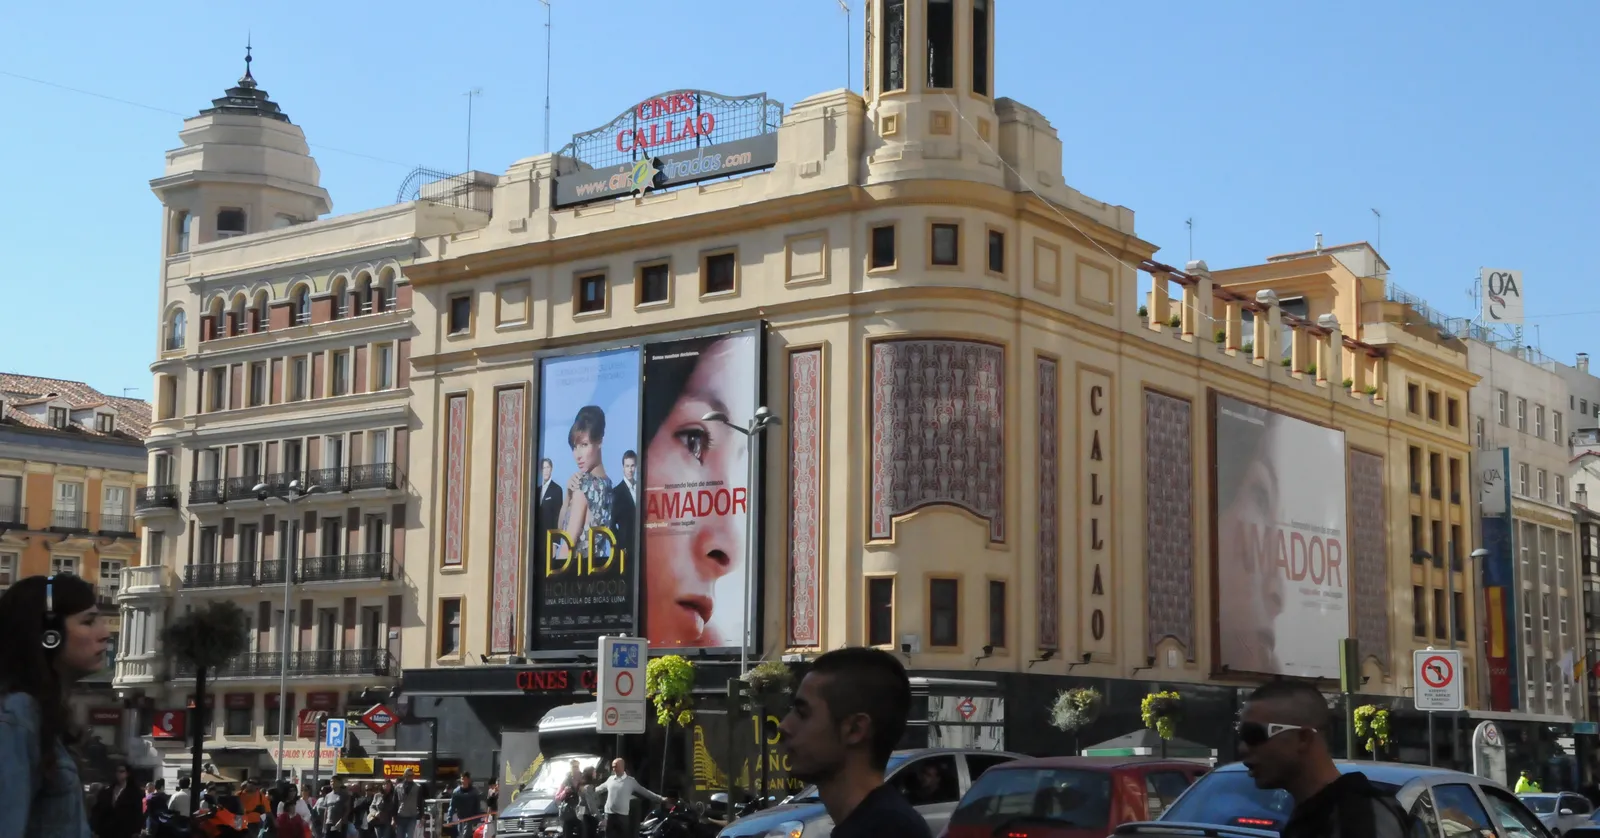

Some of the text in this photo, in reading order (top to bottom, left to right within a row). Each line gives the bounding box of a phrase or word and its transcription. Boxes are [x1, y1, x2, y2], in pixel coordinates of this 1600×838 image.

[636, 91, 694, 120] CINES
[616, 112, 715, 152] CALLAO
[645, 487, 747, 520] AMADOR
[1090, 385, 1105, 641] CALLAO
[545, 579, 627, 596] HOLLYWOOD
[516, 670, 568, 689] CINES
[330, 722, 341, 744] P
